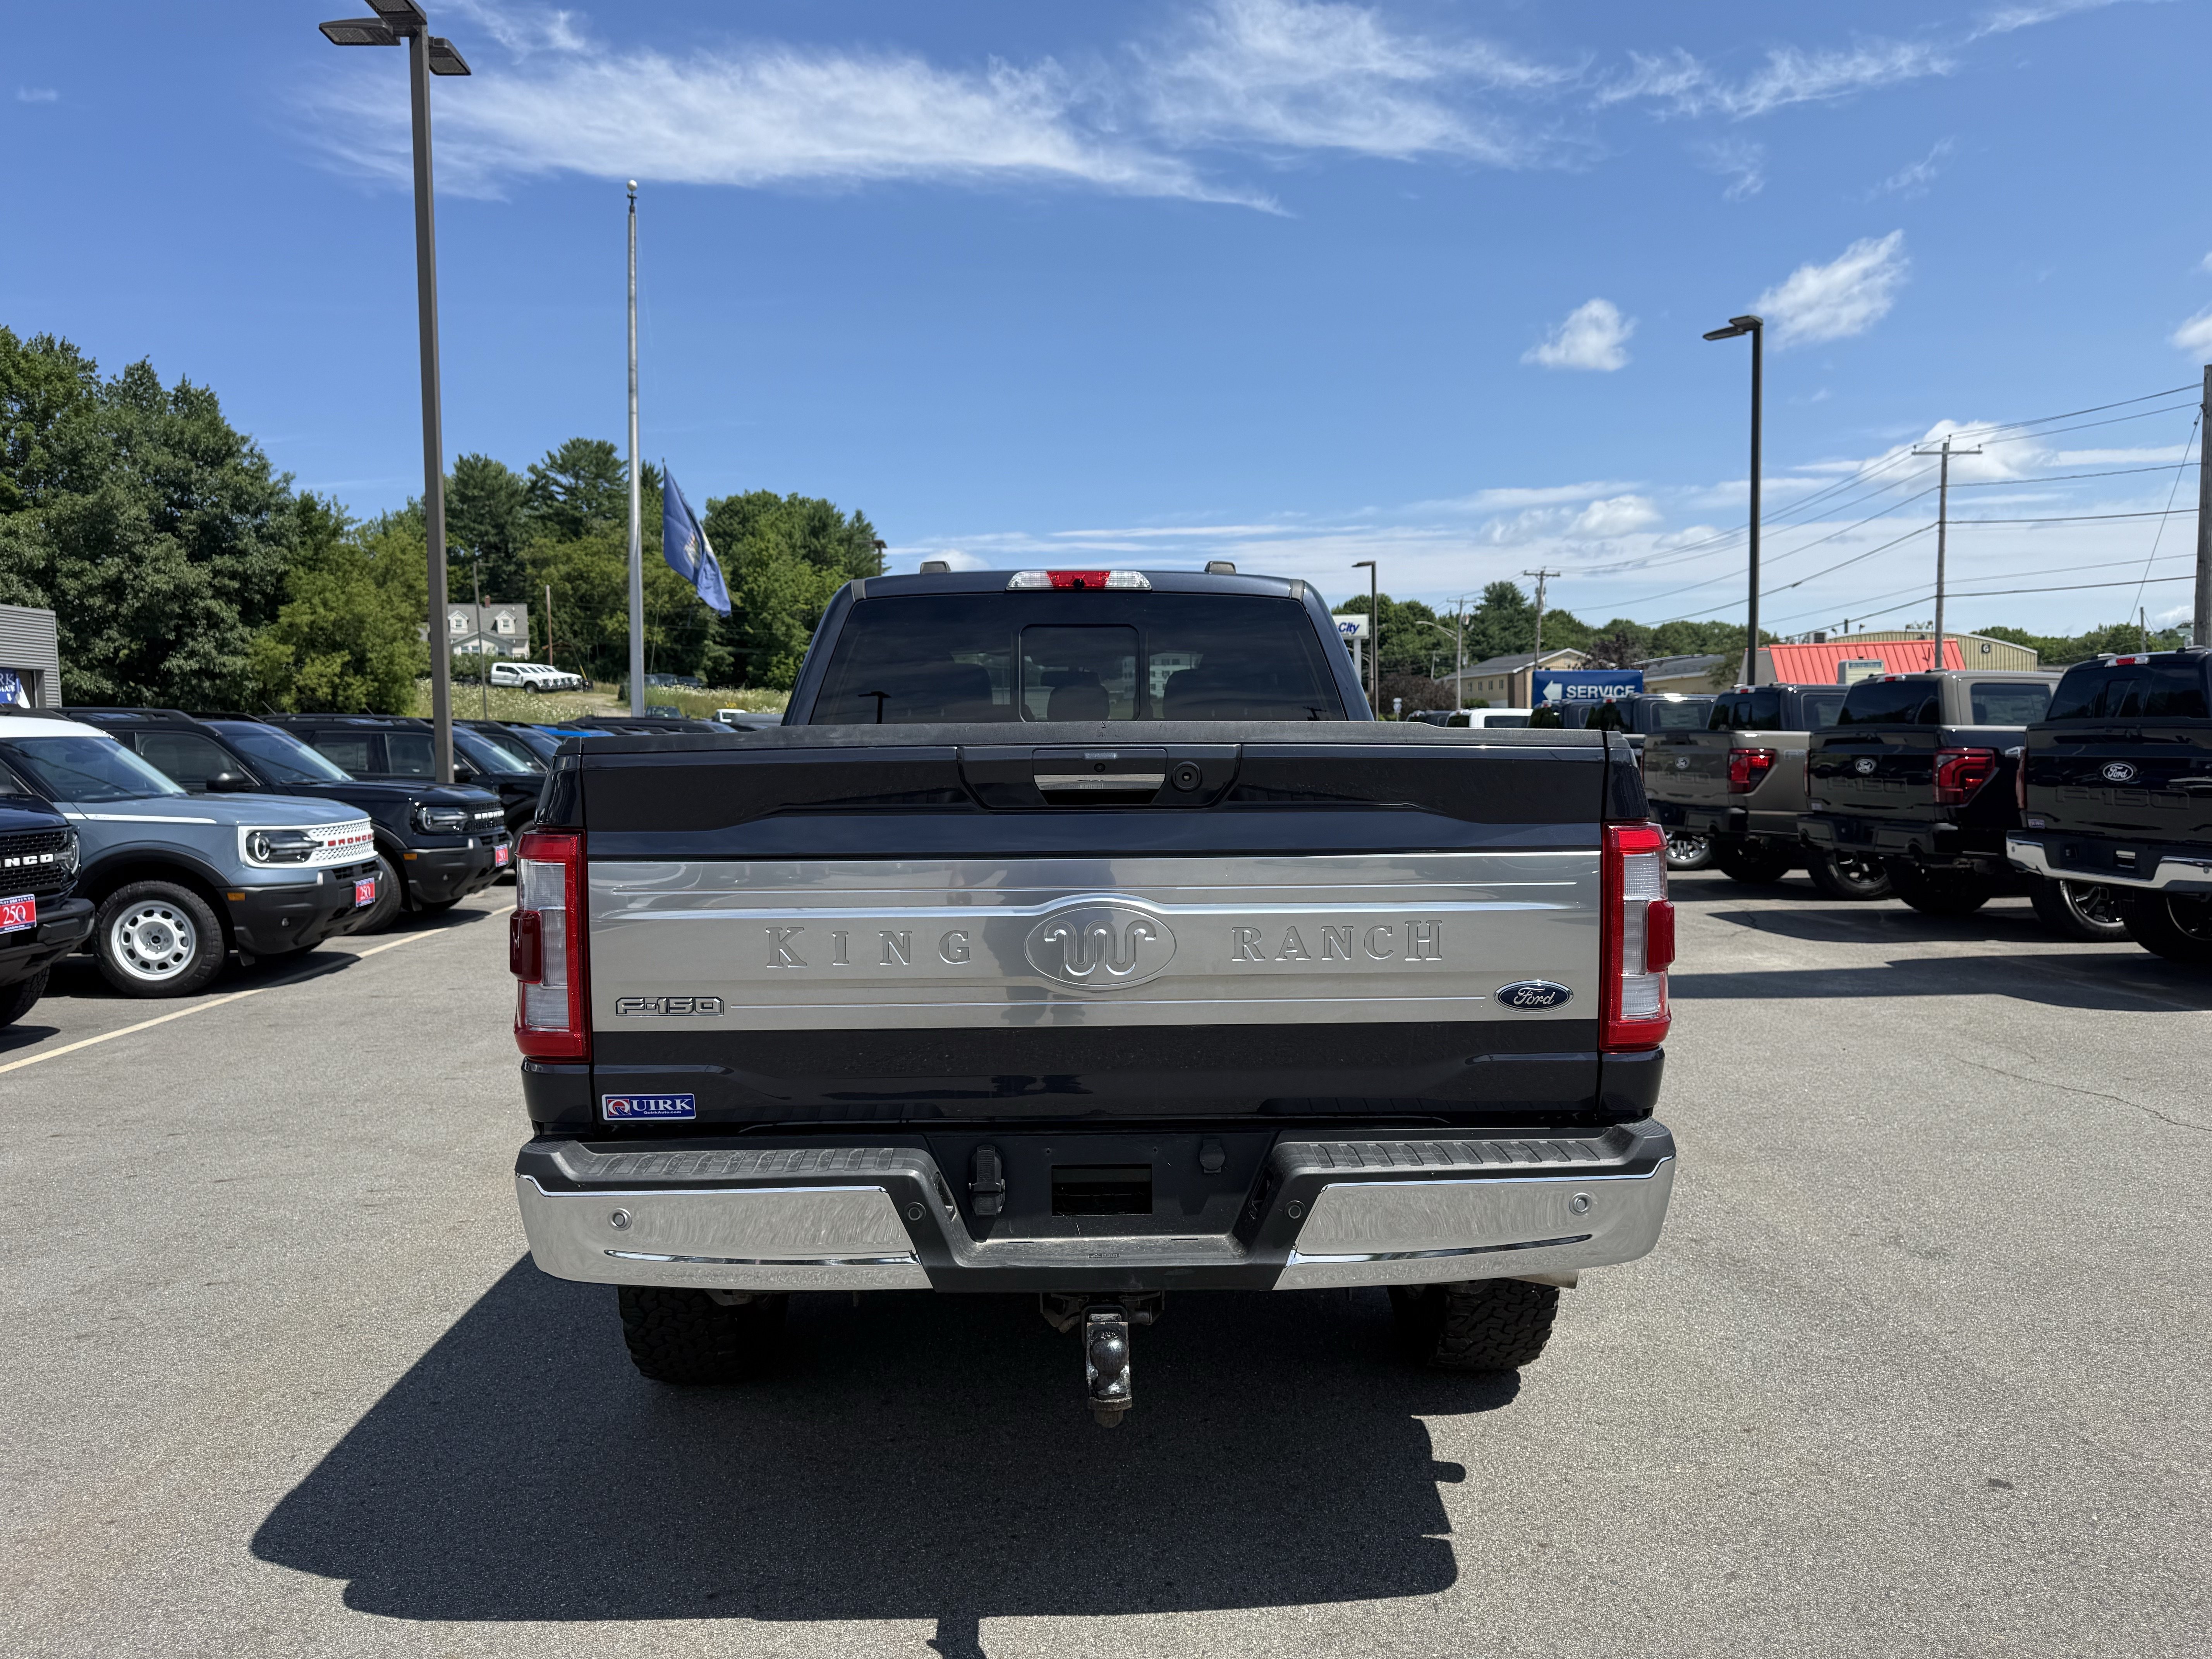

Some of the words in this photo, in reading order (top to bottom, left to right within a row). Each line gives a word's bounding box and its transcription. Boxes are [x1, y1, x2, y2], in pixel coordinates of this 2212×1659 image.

[2107, 765, 2128, 779] Ford
[2056, 785, 2190, 810] F-150
[0, 854, 53, 868] NCO
[766, 927, 970, 968] KING
[1232, 920, 1442, 961] RANCH
[1513, 987, 1556, 1005] Ford
[616, 997, 724, 1016] F-150
[607, 1099, 693, 1116] QUIRK
